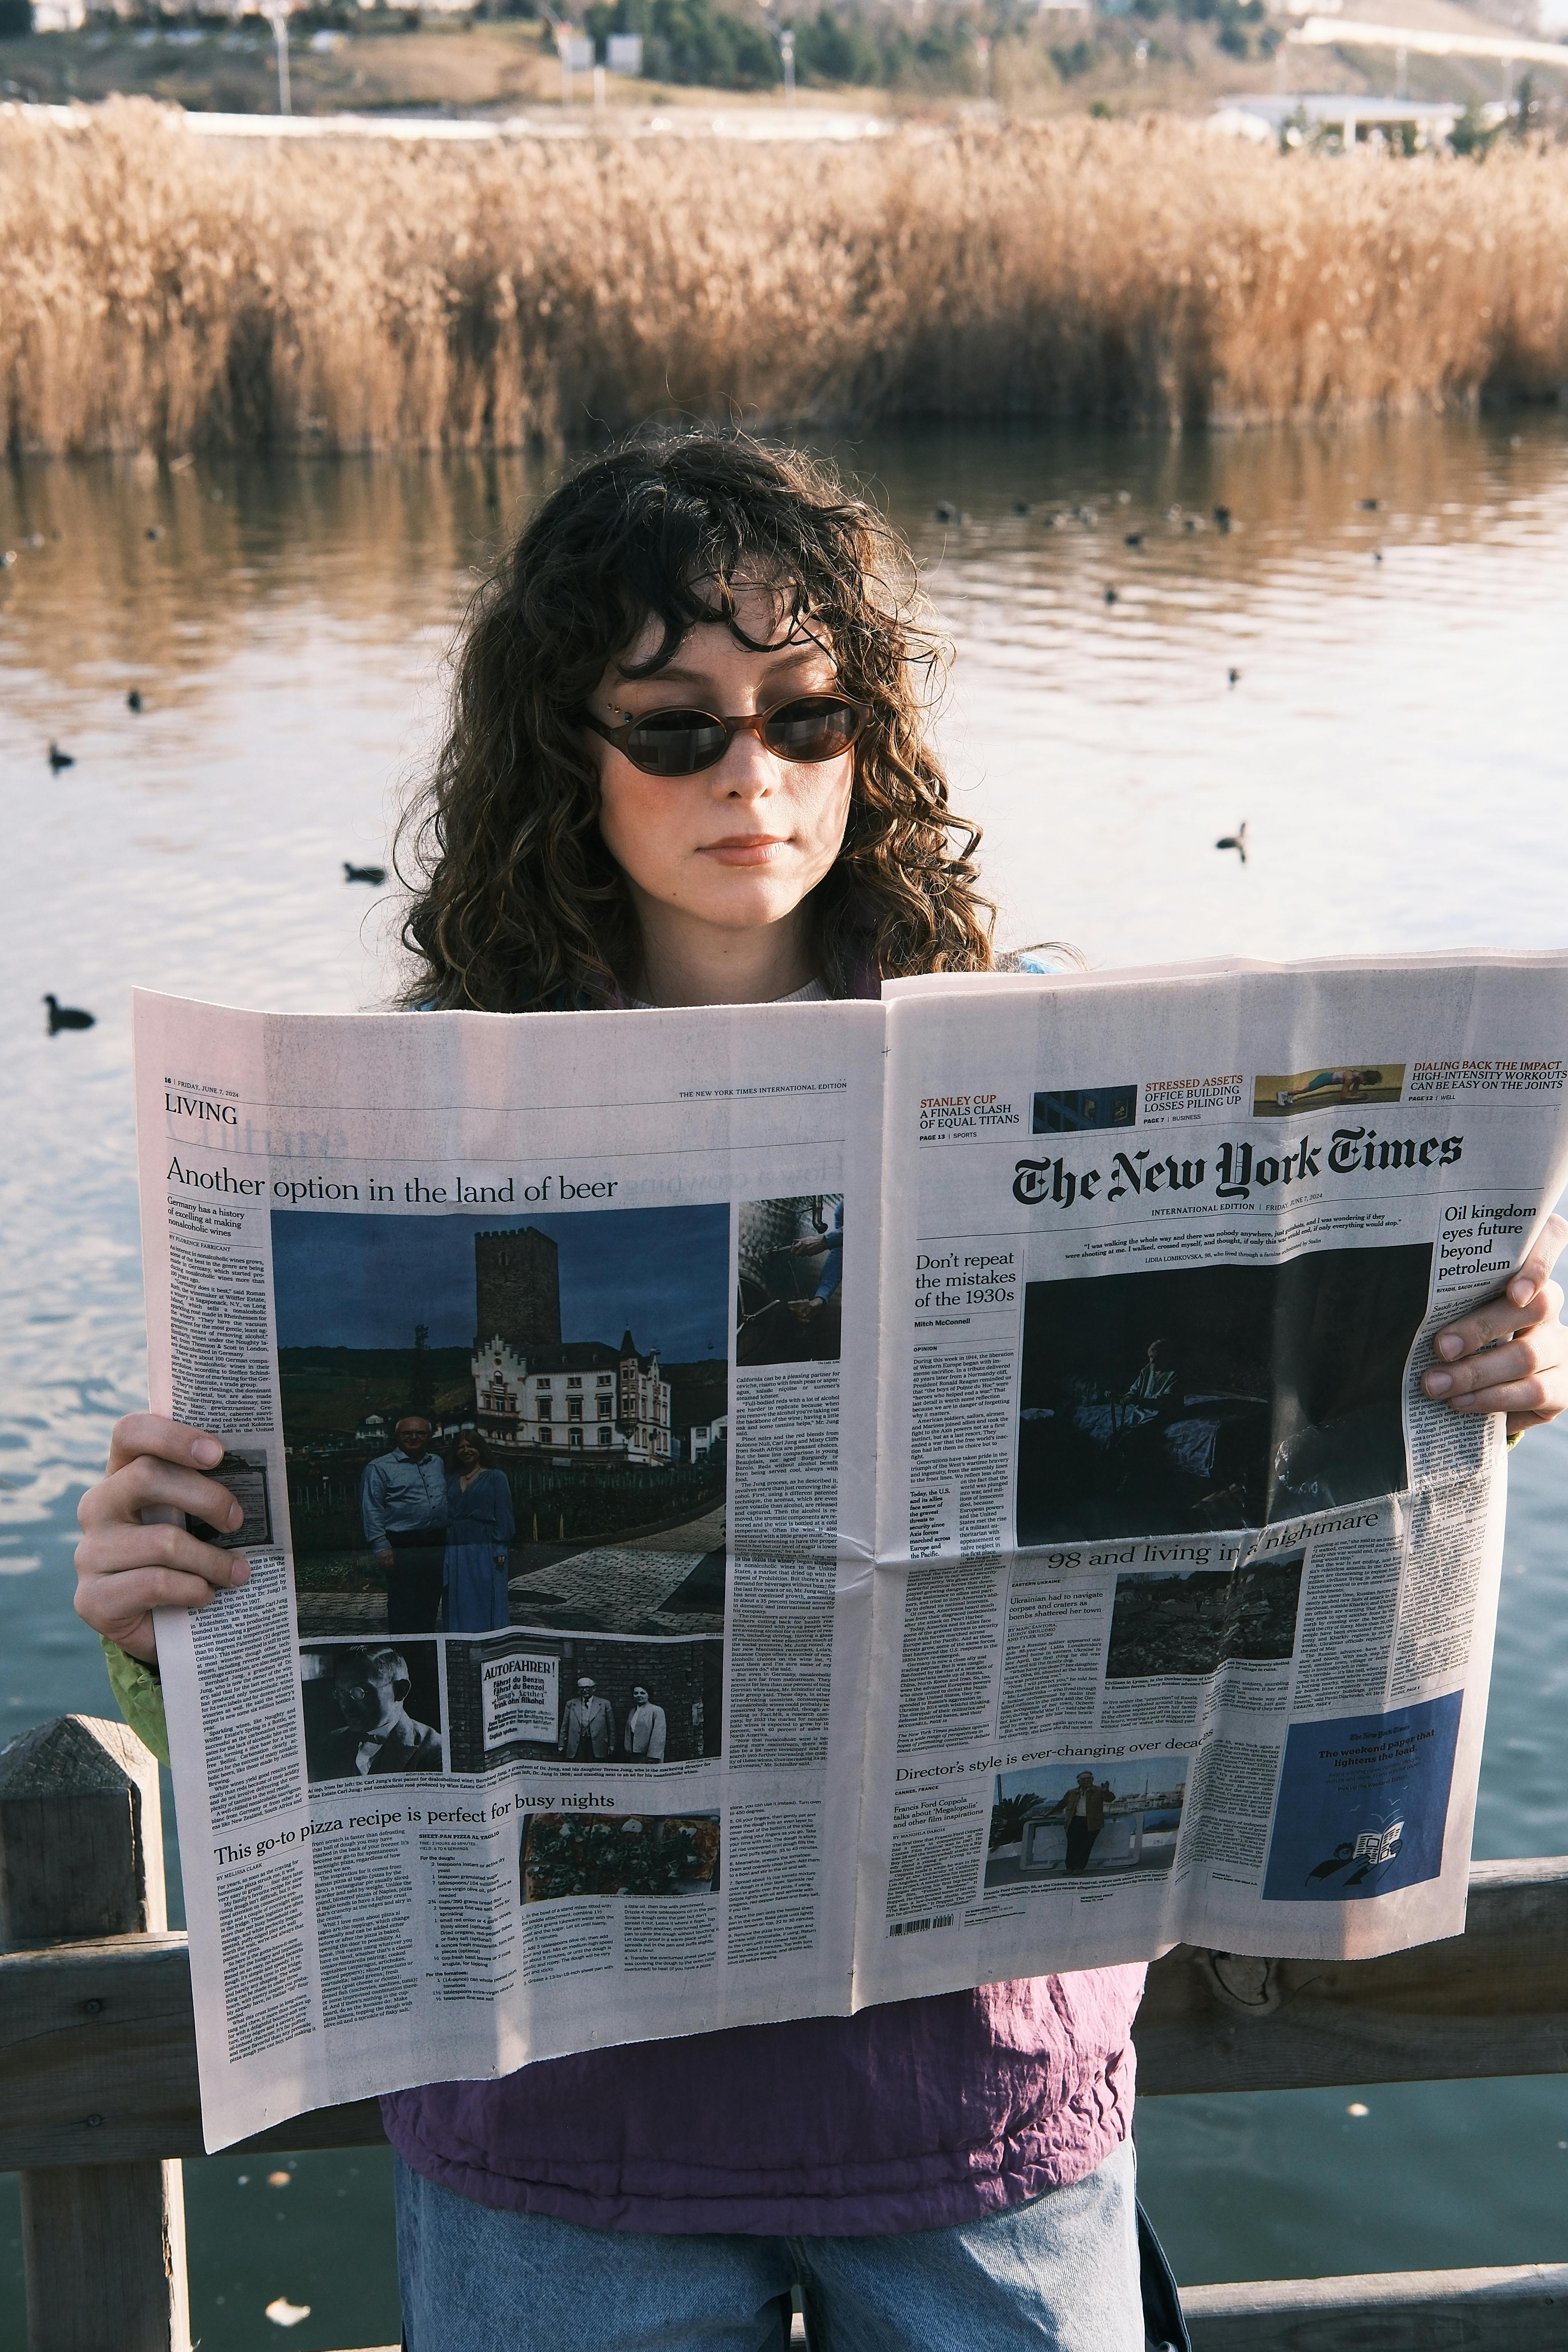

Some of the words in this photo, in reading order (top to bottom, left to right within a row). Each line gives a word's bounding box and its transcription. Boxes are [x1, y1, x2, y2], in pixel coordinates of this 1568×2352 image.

[1412, 1071, 1503, 1080] HIGH-INTENSITY
[1505, 1070, 1567, 1080] WORKOUTS
[1414, 1062, 1459, 1071] DIALING
[1462, 1061, 1492, 1069] BACK
[1520, 1061, 1562, 1070] IMPACT
[178, 1081, 200, 1090] FRIDAY,
[1145, 1079, 1199, 1092] STRESSED
[1202, 1075, 1243, 1086] ASSETS
[1525, 1081, 1562, 1089] JOINTS
[921, 1096, 971, 1108] STANLEY
[974, 1095, 996, 1104] CUP
[1145, 1091, 1183, 1101] OFFICE
[1187, 1086, 1239, 1098] BUILDING
[165, 1092, 238, 1124] LIVING
[931, 1107, 970, 1117] FINALS
[974, 1104, 1011, 1114] CLASH
[1145, 1101, 1184, 1112] LOSSES
[1187, 1098, 1223, 1108] PILING
[1227, 1096, 1241, 1104] UP
[920, 1120, 935, 1129] OF
[938, 1117, 976, 1128] EQUAL
[979, 1115, 1019, 1124] TITANS
[1013, 1157, 1101, 1209] The
[1108, 1149, 1207, 1202] New
[1216, 1135, 1322, 1202] York
[1328, 1127, 1464, 1173] Times
[167, 1157, 265, 1195] Another
[274, 1176, 359, 1203] option
[369, 1179, 395, 1201] in
[404, 1178, 446, 1203] the
[456, 1177, 514, 1202] land
[525, 1176, 551, 1201] of
[559, 1176, 618, 1199] beer
[168, 1196, 196, 1214] Germany
[199, 1204, 210, 1213] has
[219, 1208, 244, 1219] history
[1152, 1205, 1218, 1216] INTERNATIONAL
[1290, 1197, 1303, 1206] JUNE
[1445, 1206, 1467, 1221] Oil
[1471, 1204, 1536, 1220] kingdom
[169, 1216, 208, 1233] nonalcoholic
[210, 1228, 231, 1236] wines
[176, 1211, 203, 1223] excelling
[214, 1219, 241, 1230] making
[1443, 1229, 1473, 1242] eyes
[1478, 1222, 1522, 1236] future
[176, 1237, 199, 1246] FLORENCE
[1441, 1239, 1492, 1260] beyond
[916, 1253, 959, 1269] Don’t
[965, 1253, 1014, 1269] repeat
[1439, 1259, 1510, 1281] petroleum
[916, 1274, 940, 1288] the
[946, 1270, 1015, 1286] mistakes
[915, 1292, 931, 1307] of
[936, 1292, 960, 1306] the
[966, 1288, 1014, 1304] 1930s
[1048, 1553, 1081, 1568] 98
[1089, 1547, 1135, 1565] and
[1143, 1545, 1211, 1564] living
[1219, 1544, 1239, 1560] in
[1247, 1545, 1257, 1555] a
[1265, 1514, 1379, 1551] nightmare
[1011, 1596, 1046, 1604] Ukrainian
[484, 1660, 555, 1681] AUTOFAHRER!
[493, 1677, 511, 1688] Fährst
[494, 1684, 511, 1695] Fährst
[1341, 1743, 1385, 1755] weekend
[1417, 1730, 1434, 1740] that
[896, 1761, 964, 1781] Director’s
[969, 1756, 1001, 1772] style
[1006, 1755, 1017, 1764] is
[1022, 1745, 1125, 1761] ever-changing
[1130, 1743, 1161, 1752] over
[1335, 1758, 1376, 1767] lightens
[1395, 1745, 1417, 1756] load.
[894, 1804, 919, 1813] Francis
[939, 1797, 967, 1806] Coppola
[214, 1844, 251, 1865] This
[257, 1832, 295, 1856] go-to
[300, 1820, 343, 1842] pizza
[349, 1810, 401, 1828] recipe
[407, 1807, 421, 1821] is
[427, 1807, 486, 1824] perfect
[492, 1803, 511, 1819] for
[515, 1794, 555, 1809] busy
[562, 1793, 614, 1809] nights
